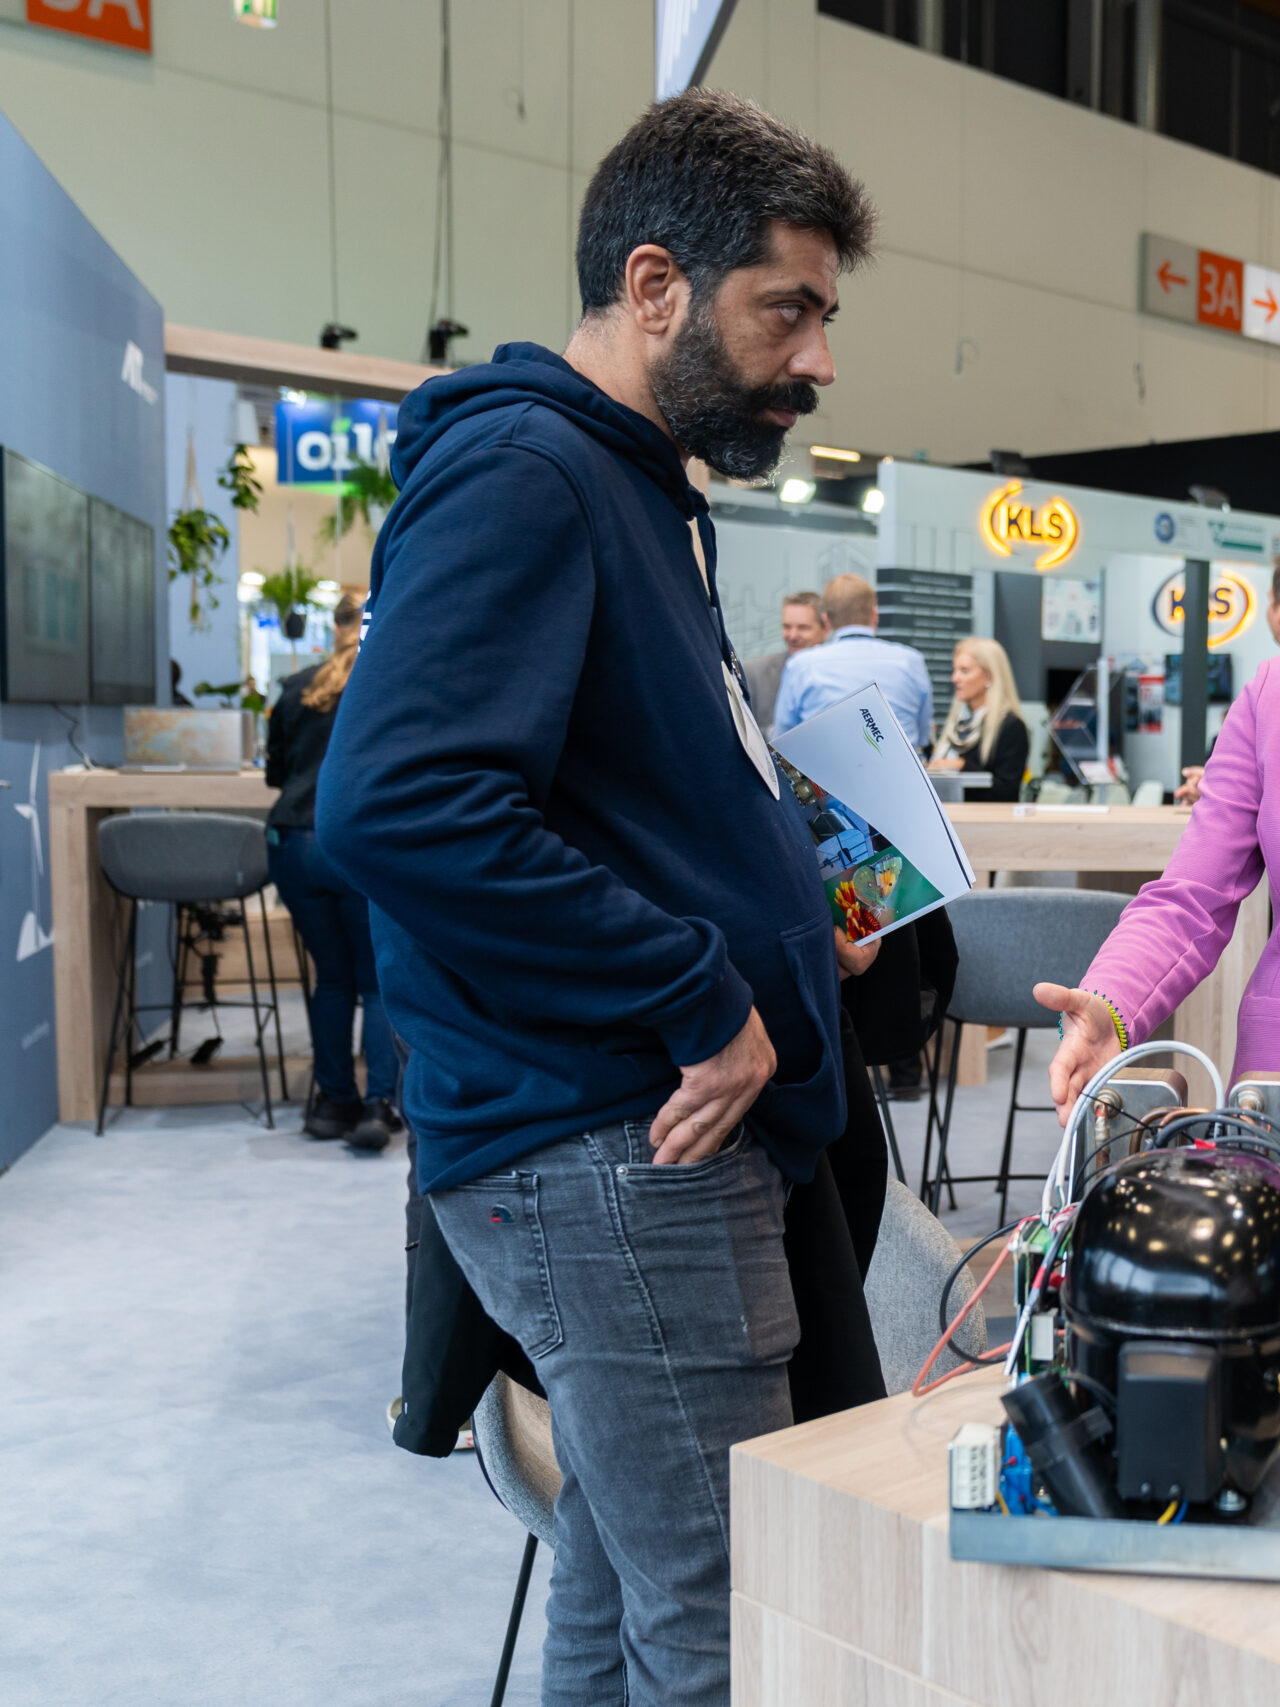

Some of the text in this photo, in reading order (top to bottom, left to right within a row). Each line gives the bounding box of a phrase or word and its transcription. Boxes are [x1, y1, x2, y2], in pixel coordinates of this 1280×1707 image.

[1202, 263, 1240, 321] 3A
[1004, 503, 1063, 540] KLS
[1171, 588, 1232, 617] KS
[859, 708, 884, 743] AERMEC
